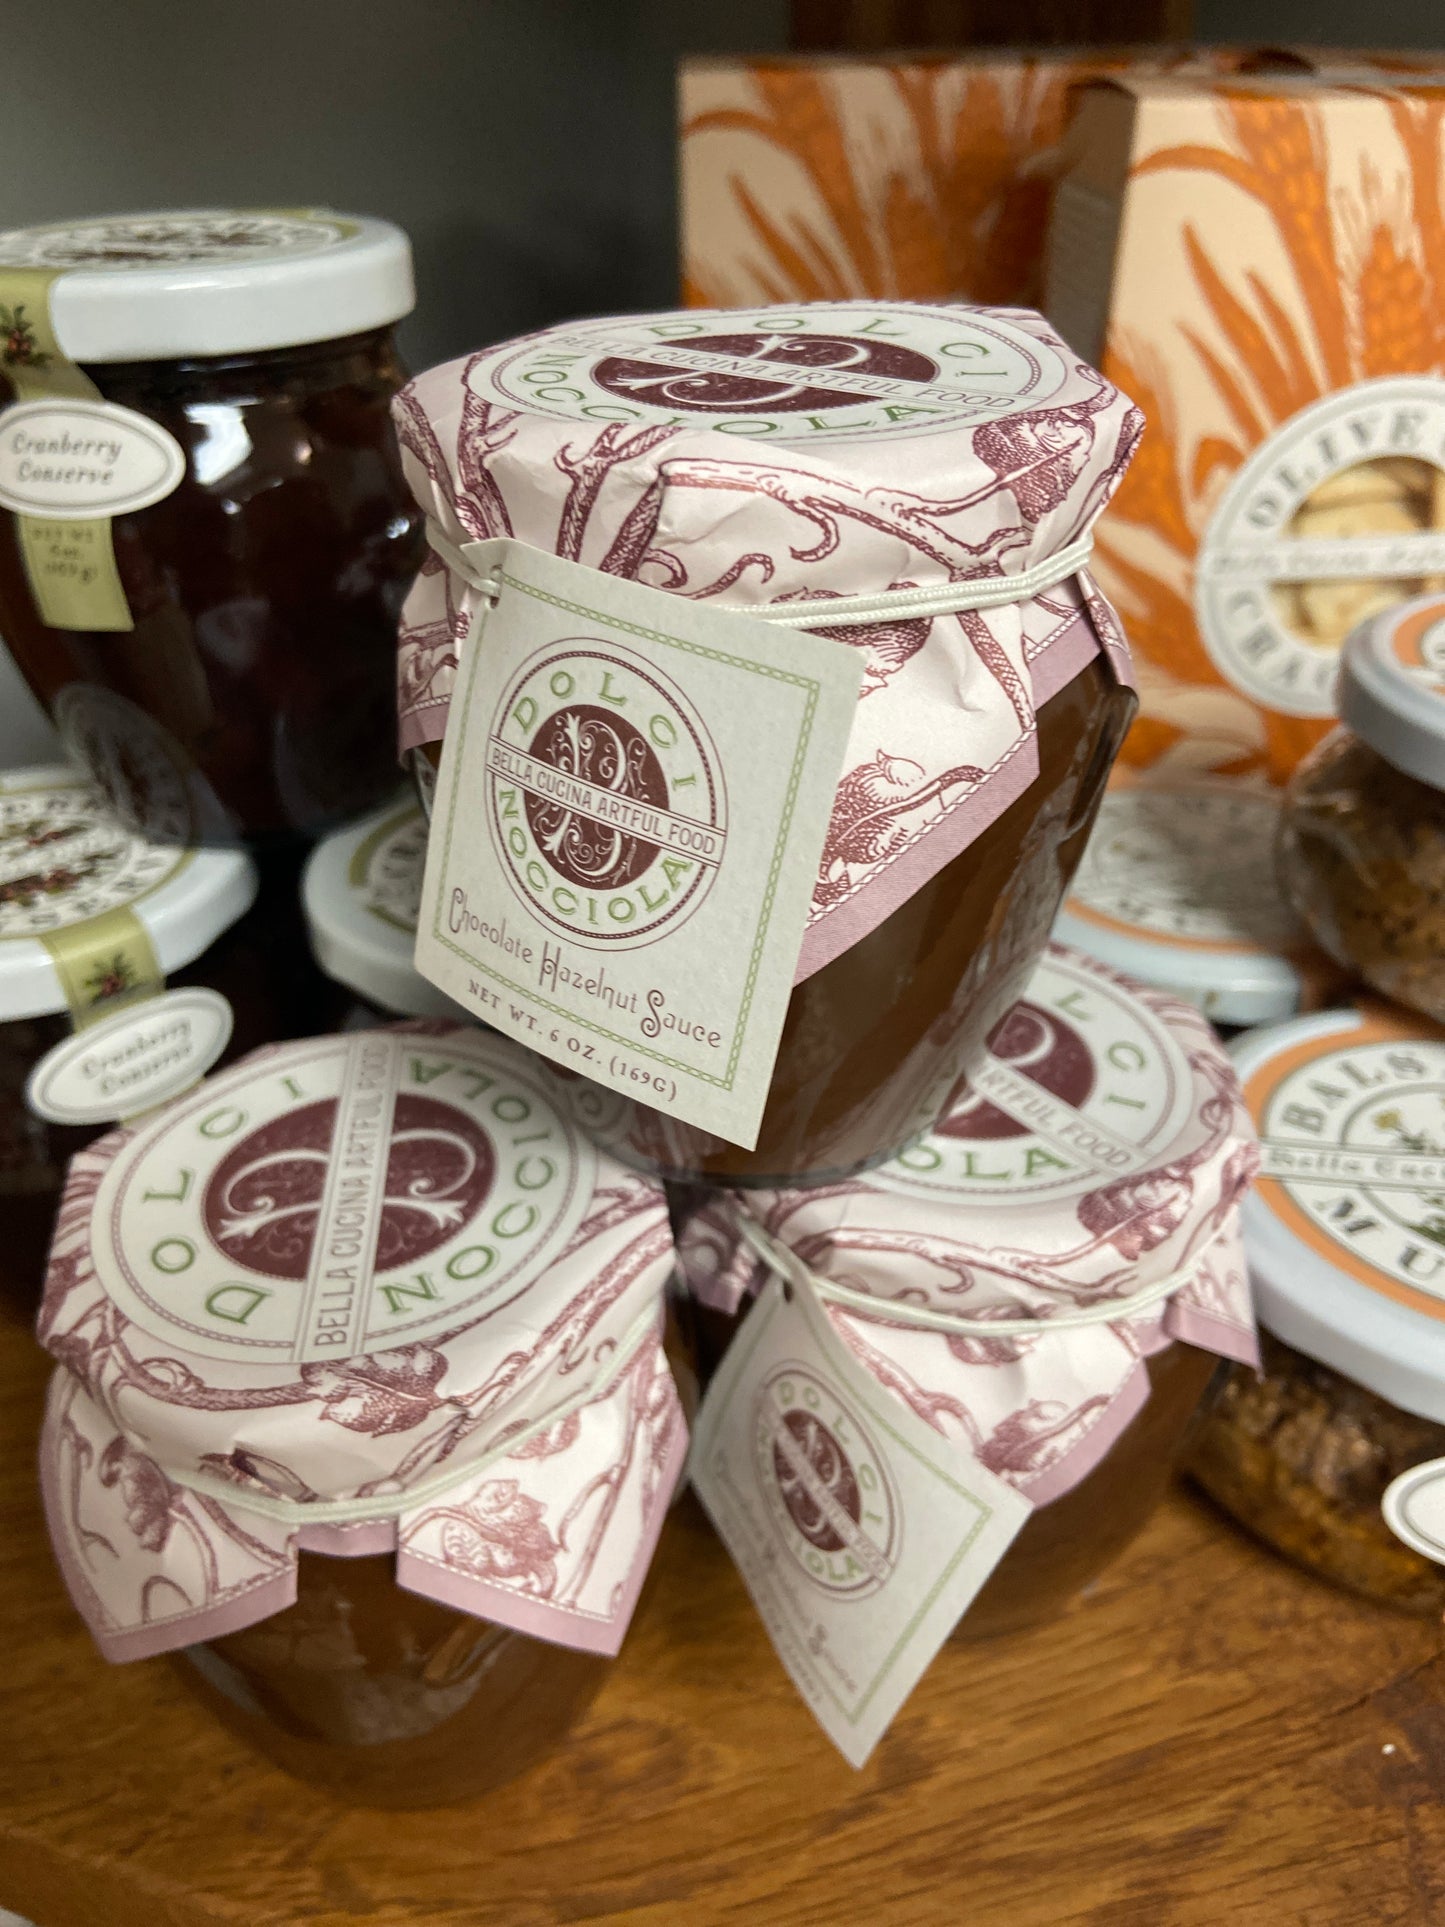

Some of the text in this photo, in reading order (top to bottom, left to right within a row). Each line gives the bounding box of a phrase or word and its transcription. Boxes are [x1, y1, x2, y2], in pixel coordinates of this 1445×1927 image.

[550, 335, 1016, 407] BELLA CUCINA ARTFUL FOOD
[648, 318, 1008, 377] DOLCI
[12, 430, 122, 464] Cranberry
[513, 670, 697, 791] DOLCI
[492, 748, 716, 855] BELLA CUCINA ARTFUL FOOD
[500, 788, 693, 925] NOCCIOLA
[449, 887, 721, 1048] Chocolate Hazelnut Sauce
[468, 979, 677, 1102] NET WT. 6 OZ. (169G)
[345, 1092, 383, 1169] ARTFUL
[1058, 1121, 1132, 1167] FOOD
[144, 1076, 305, 1325] DOLCI
[331, 1175, 371, 1258] CUCINA
[381, 1057, 555, 1314] NOCCIOLA
[314, 1264, 357, 1347] BELLA
[779, 1381, 883, 1524] DOLCI
